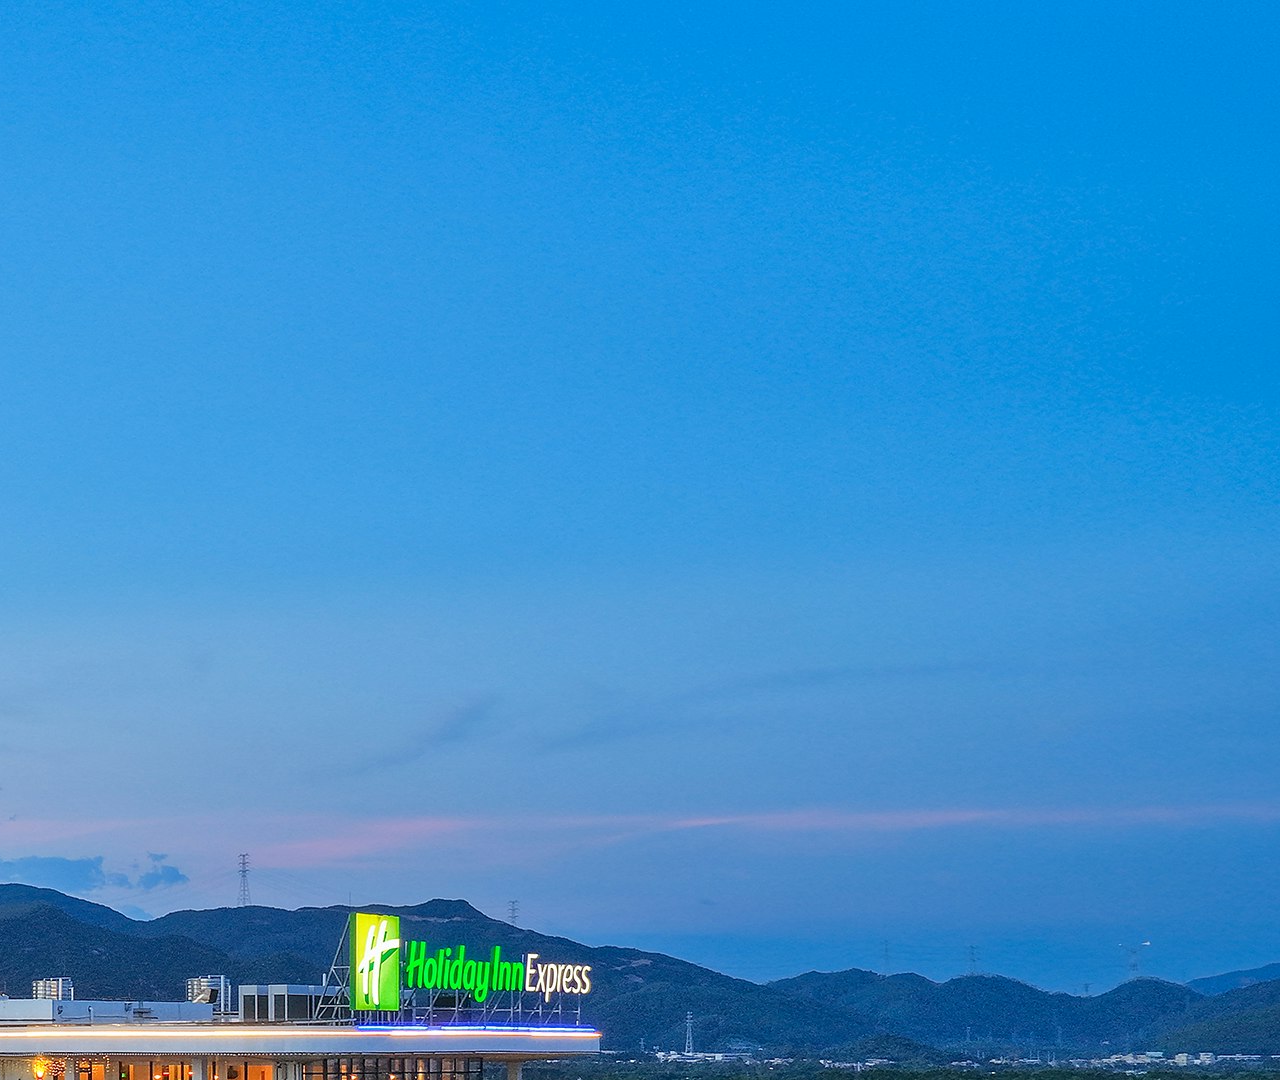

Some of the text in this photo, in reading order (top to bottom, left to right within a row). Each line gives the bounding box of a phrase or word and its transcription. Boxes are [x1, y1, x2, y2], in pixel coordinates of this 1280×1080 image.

[406, 940, 593, 1003] Holiday Inn Express
